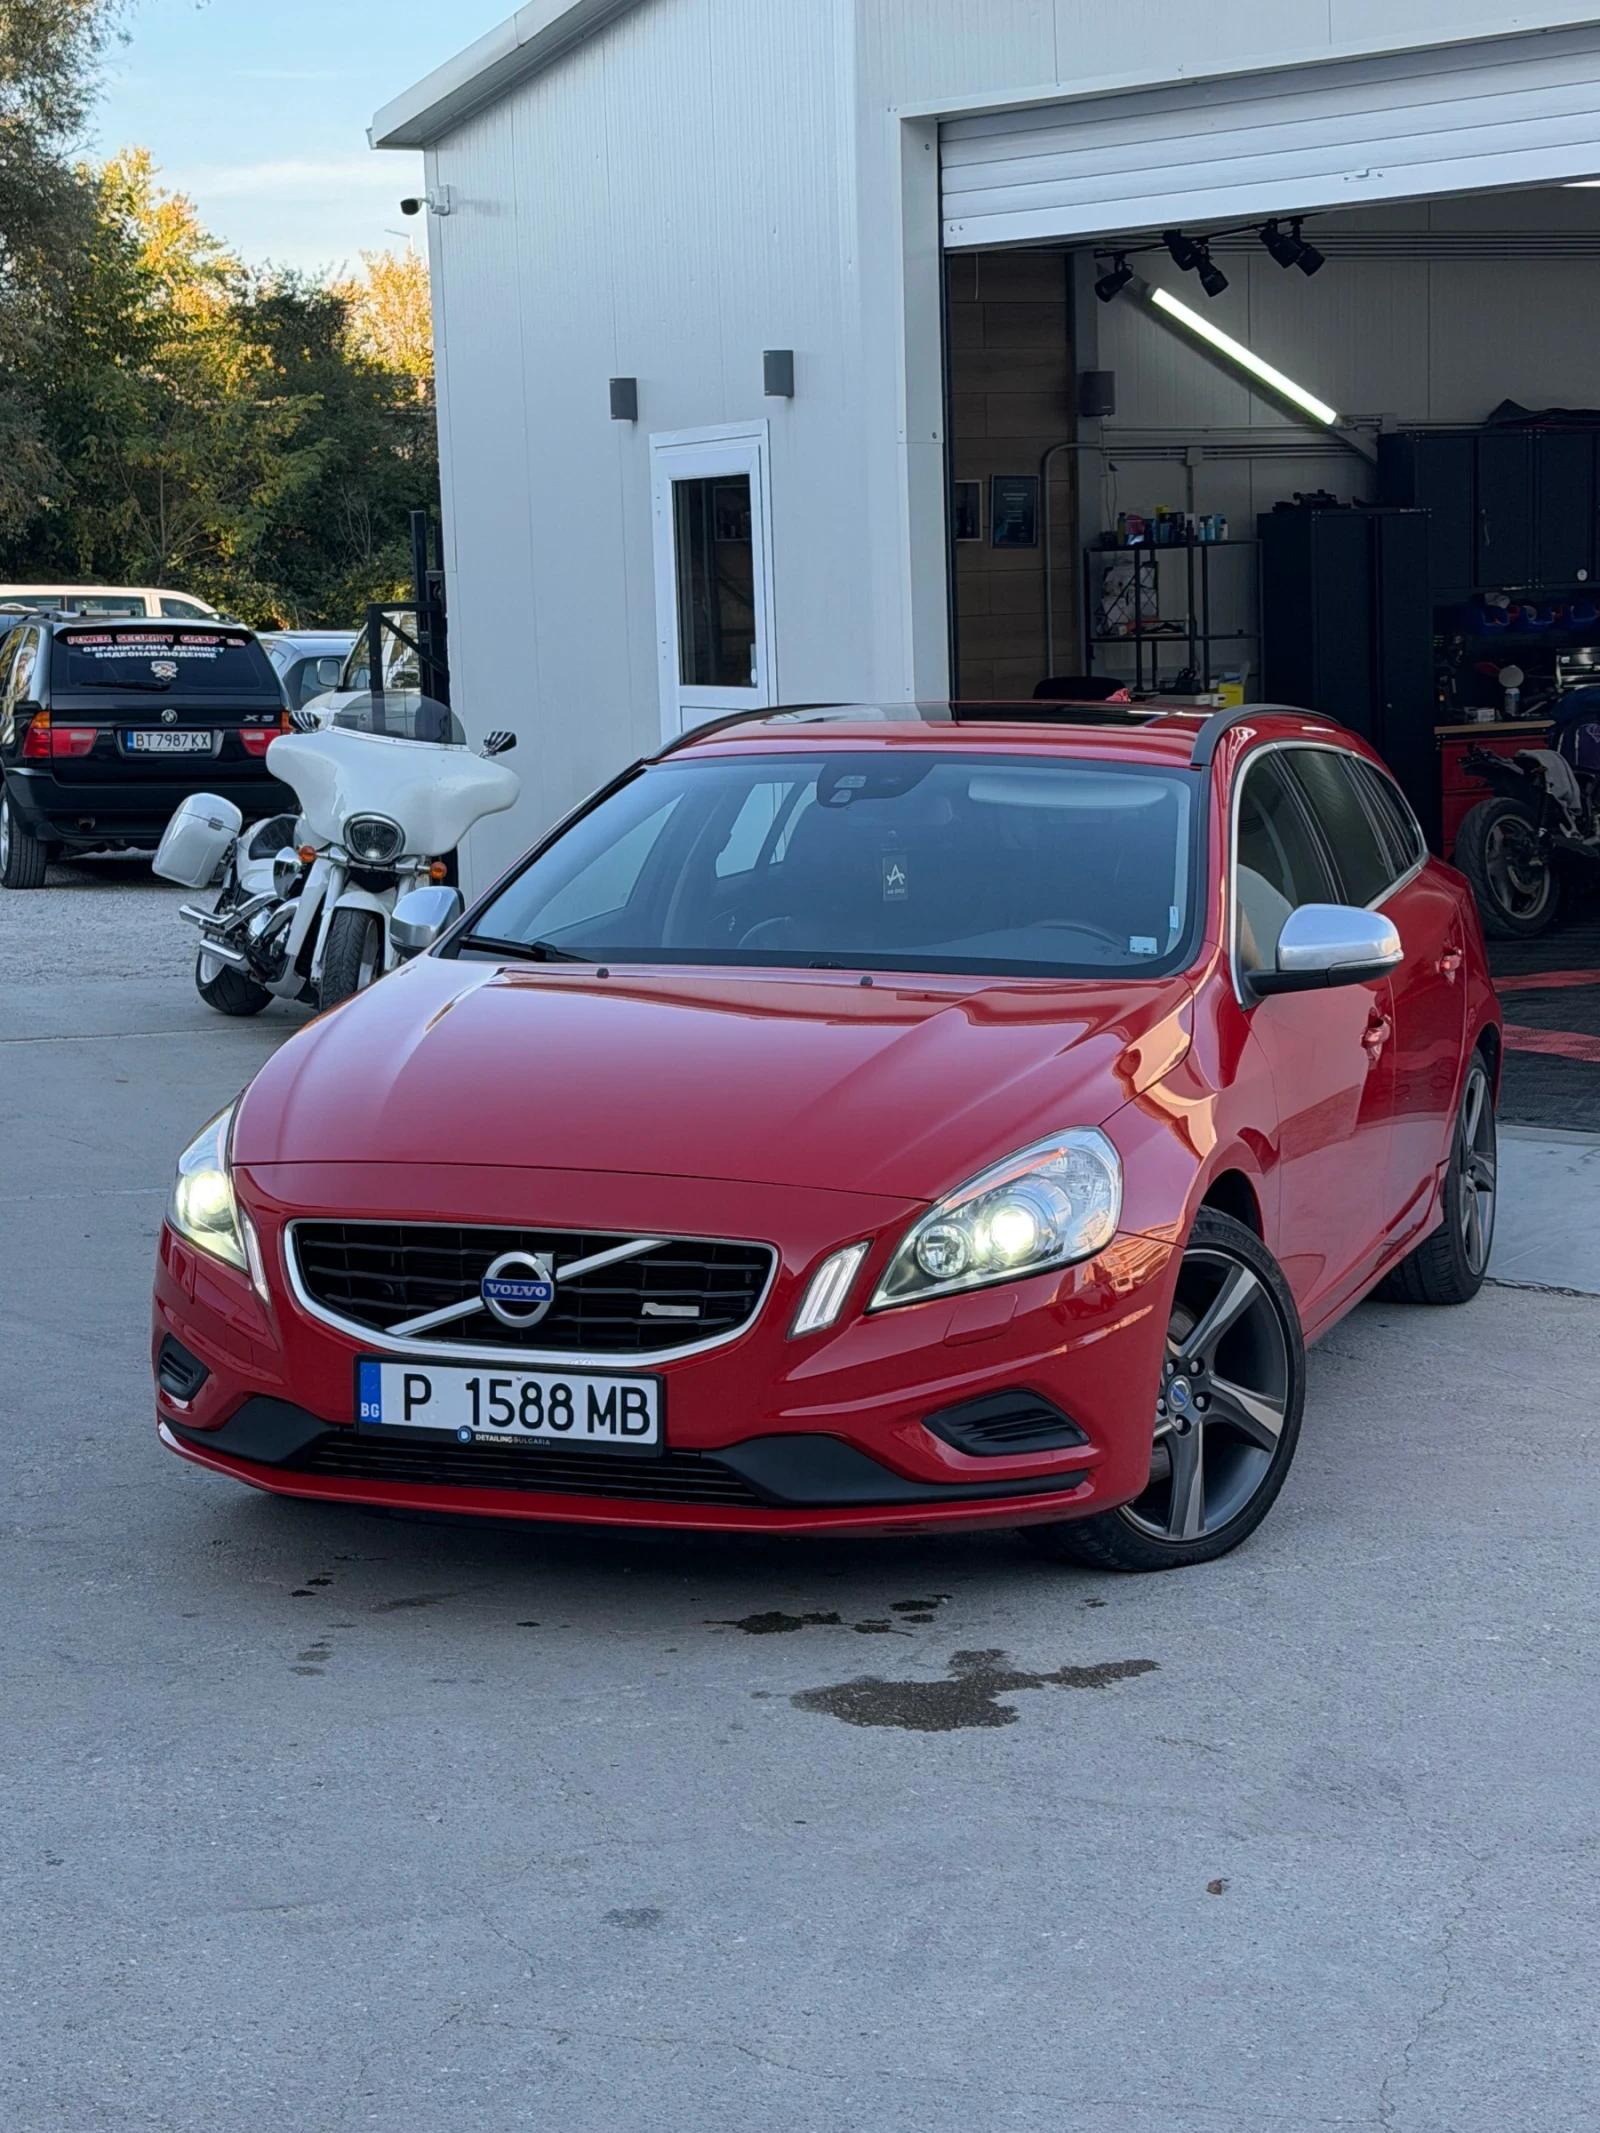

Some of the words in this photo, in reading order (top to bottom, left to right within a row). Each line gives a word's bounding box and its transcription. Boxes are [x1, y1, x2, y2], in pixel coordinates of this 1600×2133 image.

[116, 634, 174, 643] SECURITY
[155, 733, 189, 747] 7987
[486, 1282, 547, 1297] VOLVO
[360, 1402, 380, 1418] BG
[403, 1373, 432, 1421] P
[465, 1377, 574, 1432] 1588
[587, 1384, 650, 1436] MB
